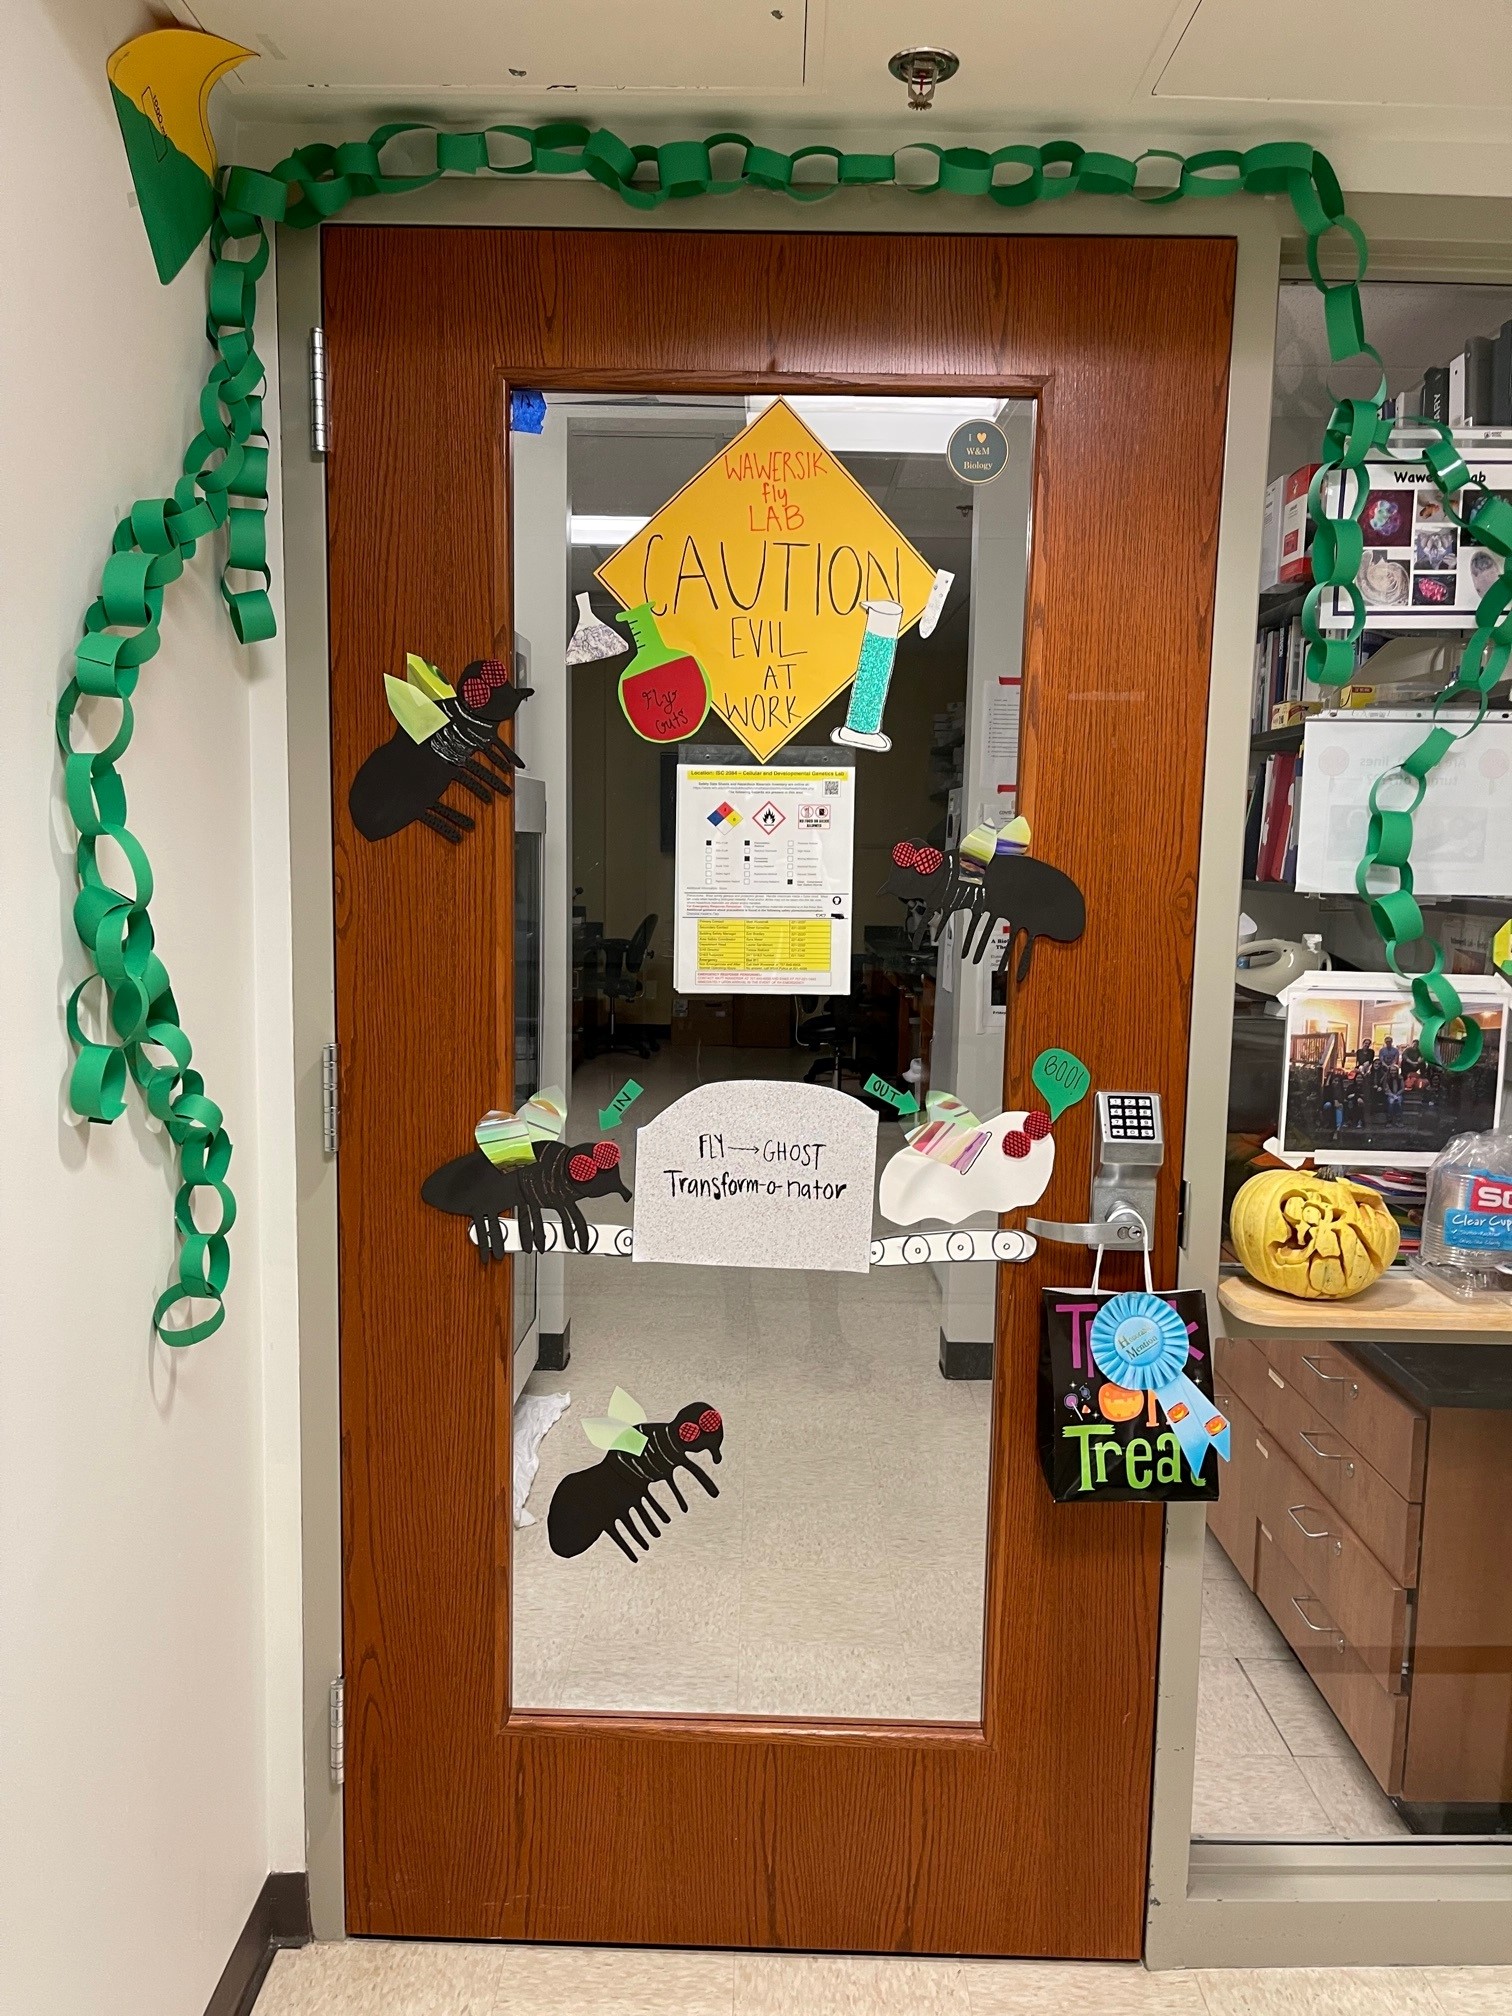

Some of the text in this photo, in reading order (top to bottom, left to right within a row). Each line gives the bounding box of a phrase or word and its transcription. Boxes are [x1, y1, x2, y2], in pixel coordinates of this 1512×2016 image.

[966, 447, 990, 455] W&M
[968, 433, 972, 442] I
[724, 451, 828, 483] WAWERSIK
[963, 461, 993, 470] Biology
[749, 505, 805, 532] LAB
[643, 534, 902, 617] CAUTION
[731, 616, 808, 659] EVIL
[764, 663, 797, 690] AT
[724, 692, 802, 732] WORK
[1043, 1057, 1083, 1094] BOO!
[612, 1092, 632, 1112] IN
[872, 1078, 901, 1102] OUT
[699, 1133, 827, 1171] FLY GHOST
[1452, 1214, 1486, 1226] Clear
[1126, 1335, 1158, 1360] Mention
